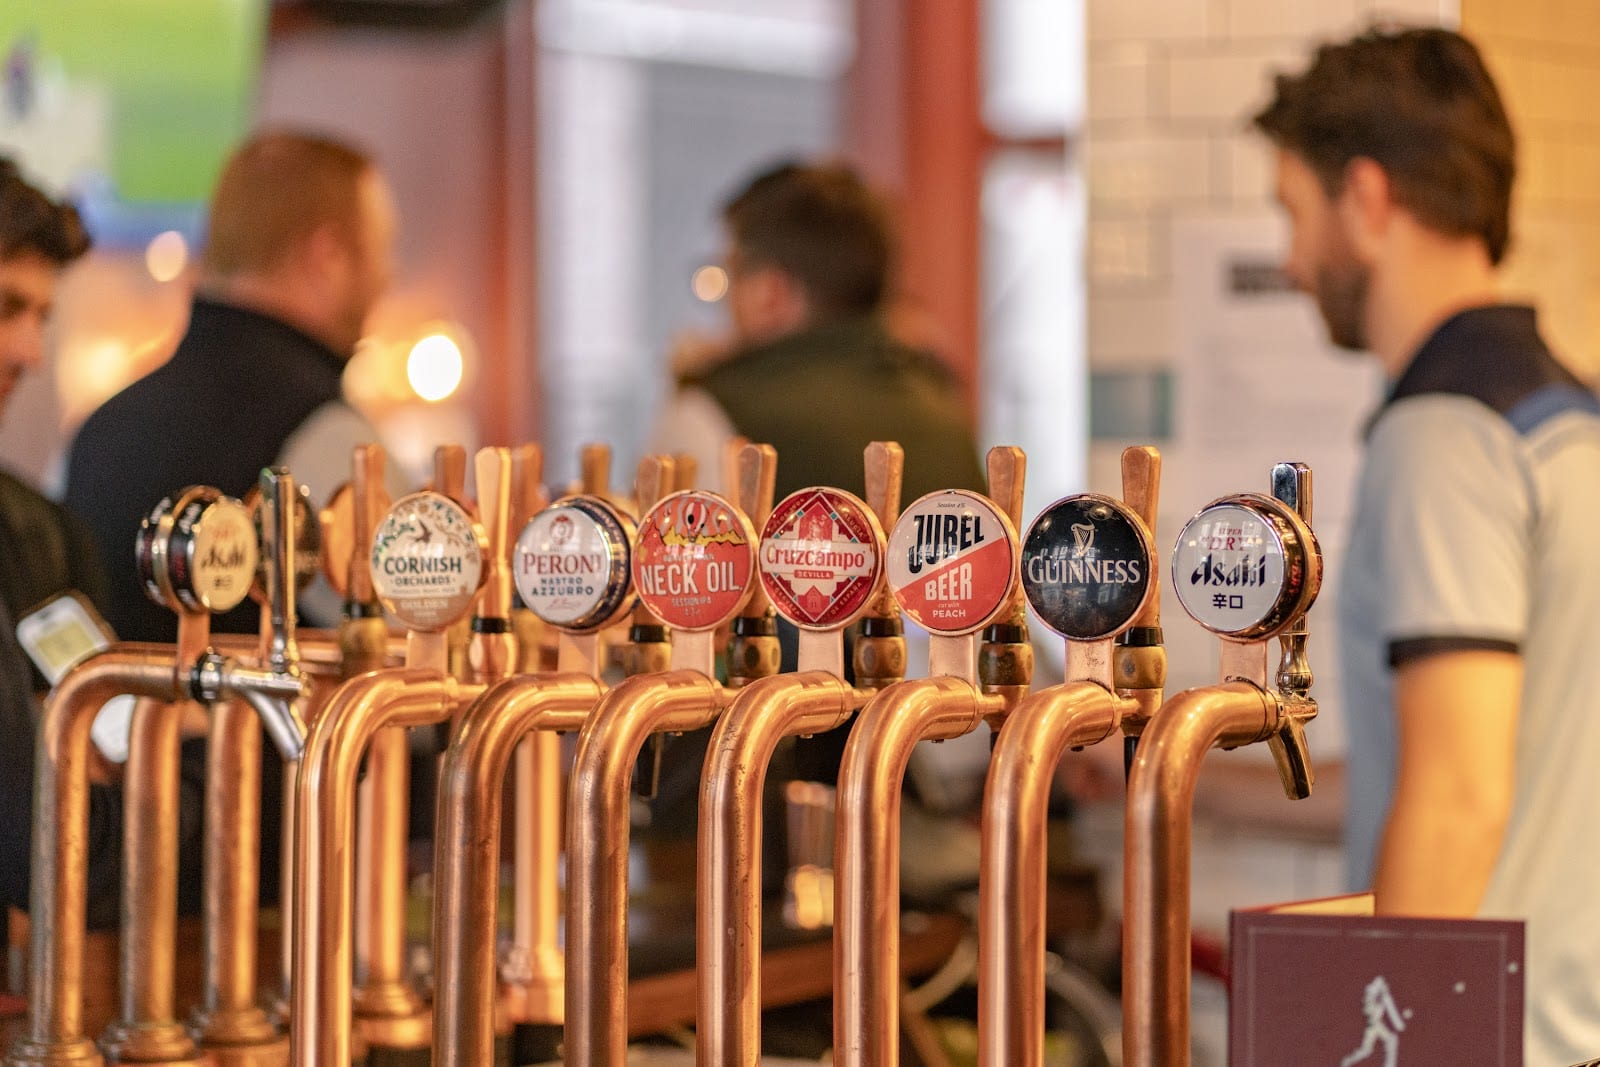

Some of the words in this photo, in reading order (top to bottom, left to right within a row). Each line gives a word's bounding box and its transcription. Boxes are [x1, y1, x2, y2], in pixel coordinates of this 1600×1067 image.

[908, 514, 984, 574] JUBEL
[384, 556, 462, 575] CORNISH
[523, 552, 603, 574] PERONI
[767, 543, 865, 570] Cruzcampo
[641, 562, 699, 596] NECK
[797, 571, 831, 579] SEVILLA
[1027, 556, 1141, 584] GUINNESS
[1190, 553, 1266, 587] Asahi
[395, 576, 450, 587] ORCHARDS
[540, 577, 583, 585] NASTRO
[925, 562, 973, 601] BEER
[532, 586, 595, 597] AZZURRO
[1212, 593, 1243, 609] 辛口
[932, 609, 966, 618] PEACH
